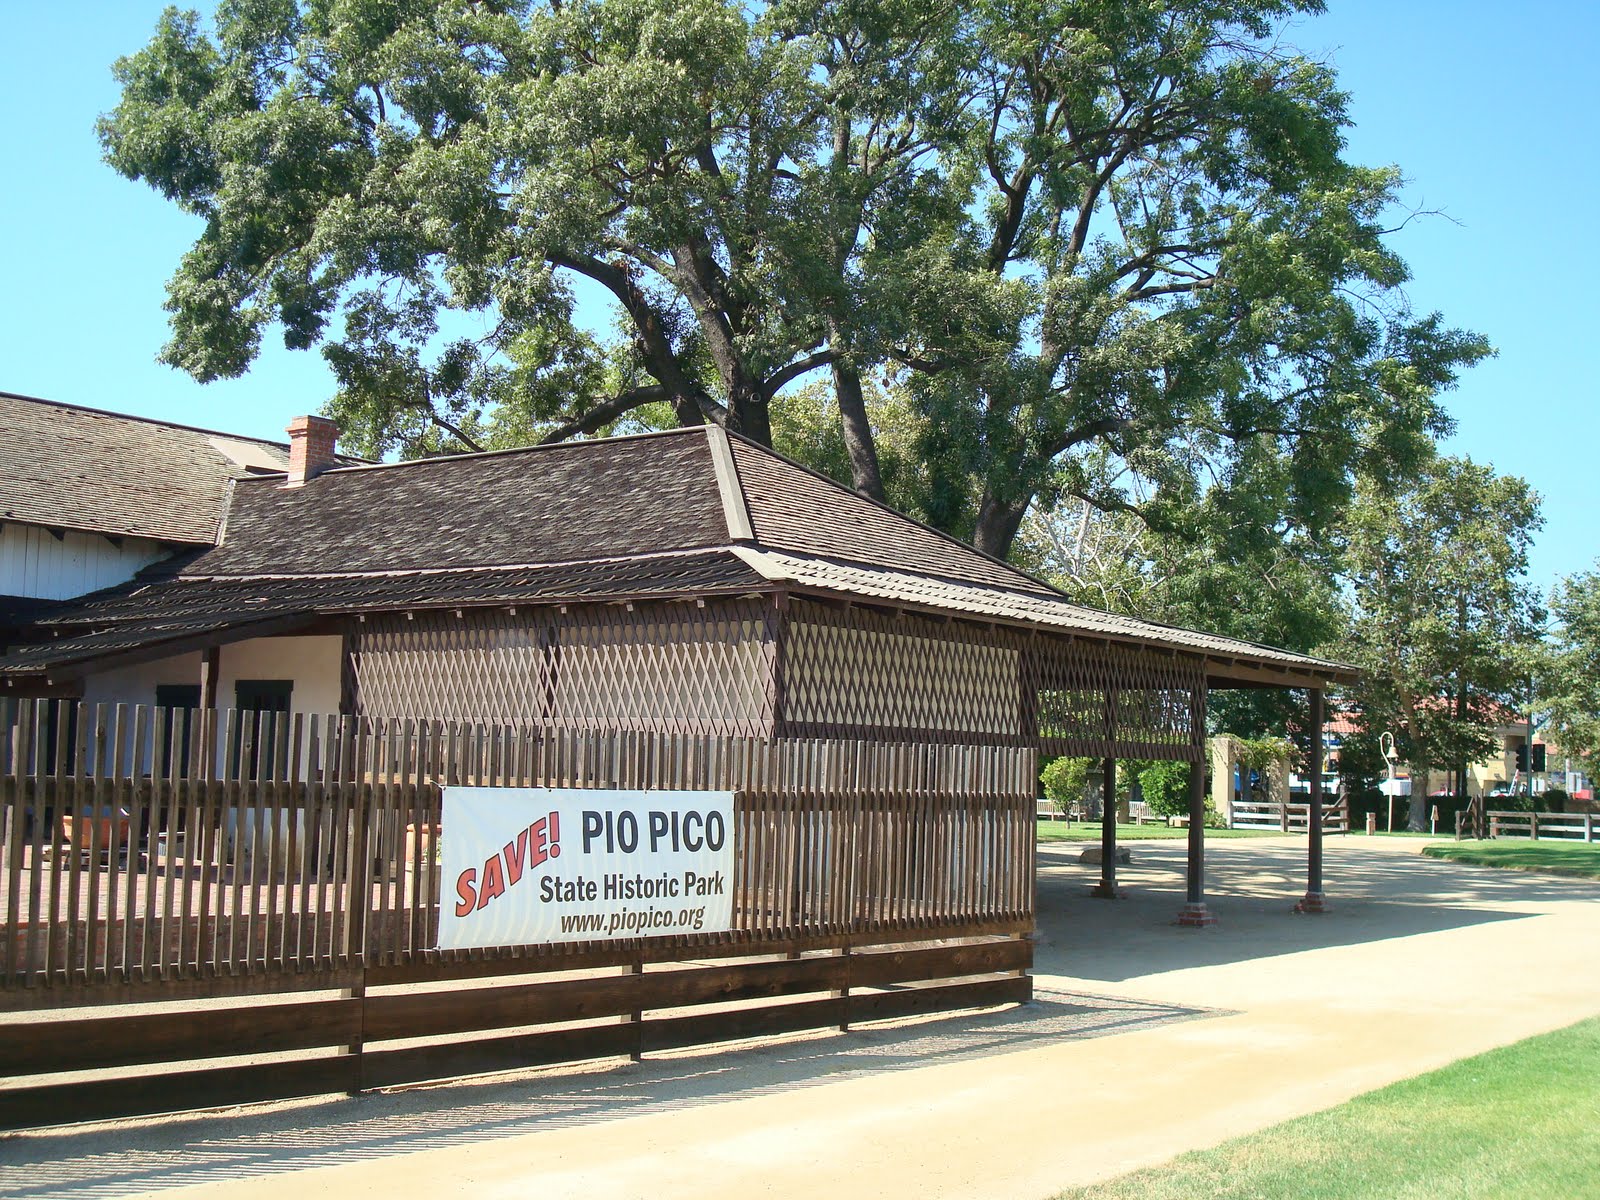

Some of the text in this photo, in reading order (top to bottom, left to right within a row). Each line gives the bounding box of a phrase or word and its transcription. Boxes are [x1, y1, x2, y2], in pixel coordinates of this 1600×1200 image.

[582, 811, 725, 854] PIO PICO
[455, 811, 561, 917] SAVE!
[540, 871, 724, 902] State Historic Park
[561, 906, 705, 935] www.piopico.org
